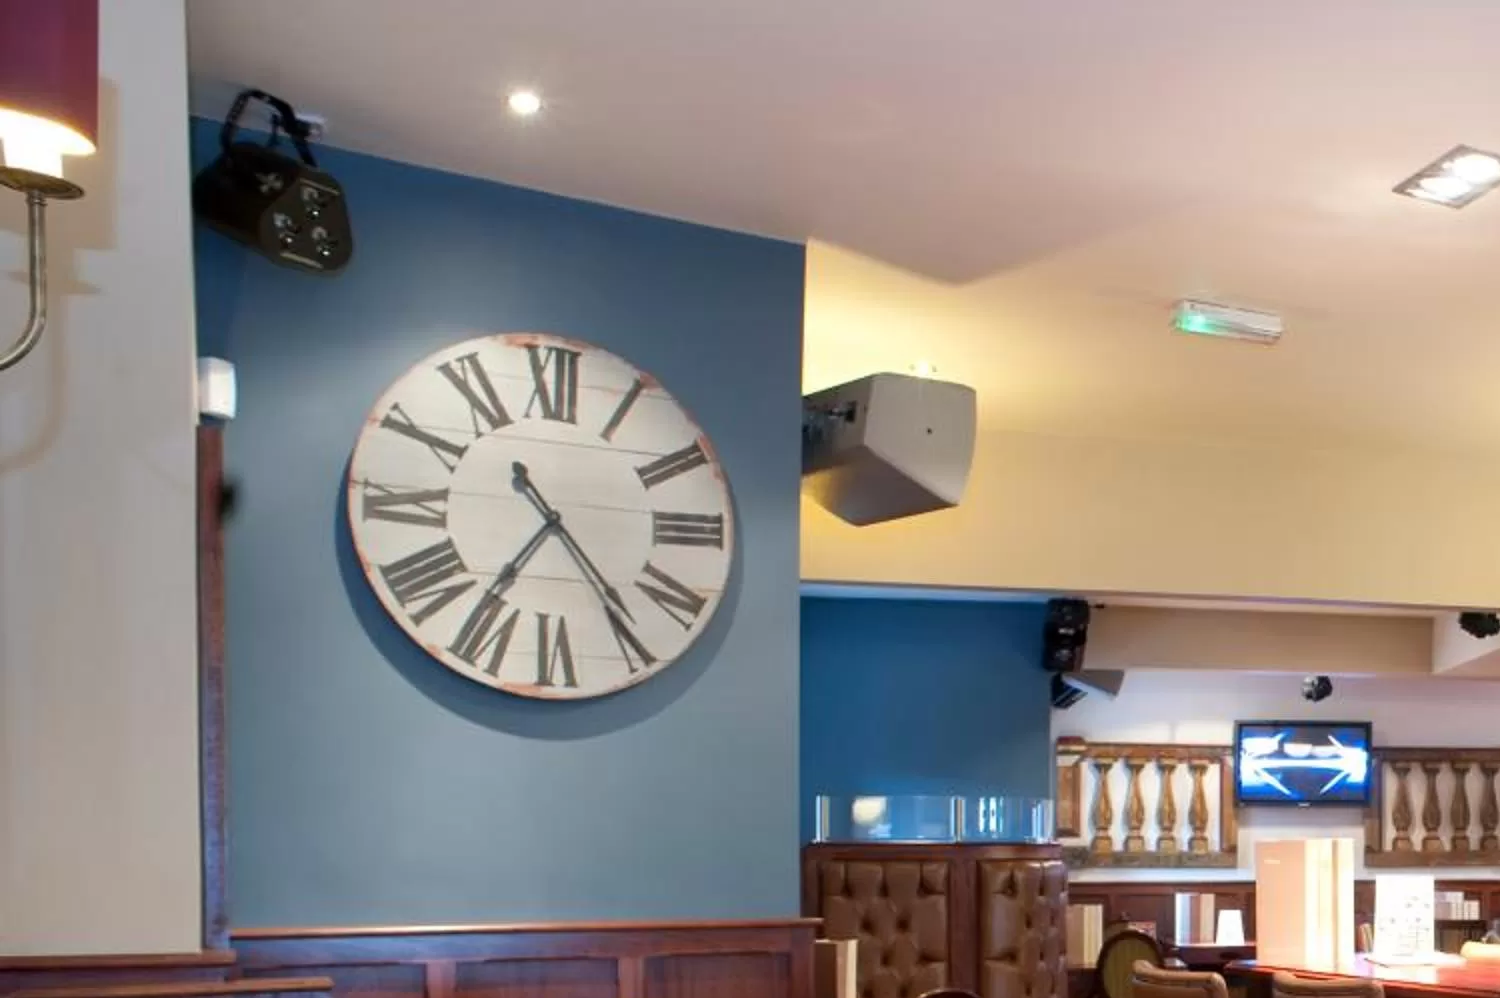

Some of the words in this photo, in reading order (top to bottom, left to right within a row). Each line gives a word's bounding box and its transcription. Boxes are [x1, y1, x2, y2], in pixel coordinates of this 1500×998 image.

[437, 351, 515, 438] XI
[523, 344, 582, 425] XII
[600, 377, 645, 442] I
[380, 402, 469, 474] X
[635, 438, 709, 491] II
[362, 478, 449, 529] IX
[652, 511, 724, 551] III
[379, 536, 478, 627] VIII
[635, 560, 707, 632] IV
[446, 592, 520, 677] VII
[534, 611, 578, 688] VI
